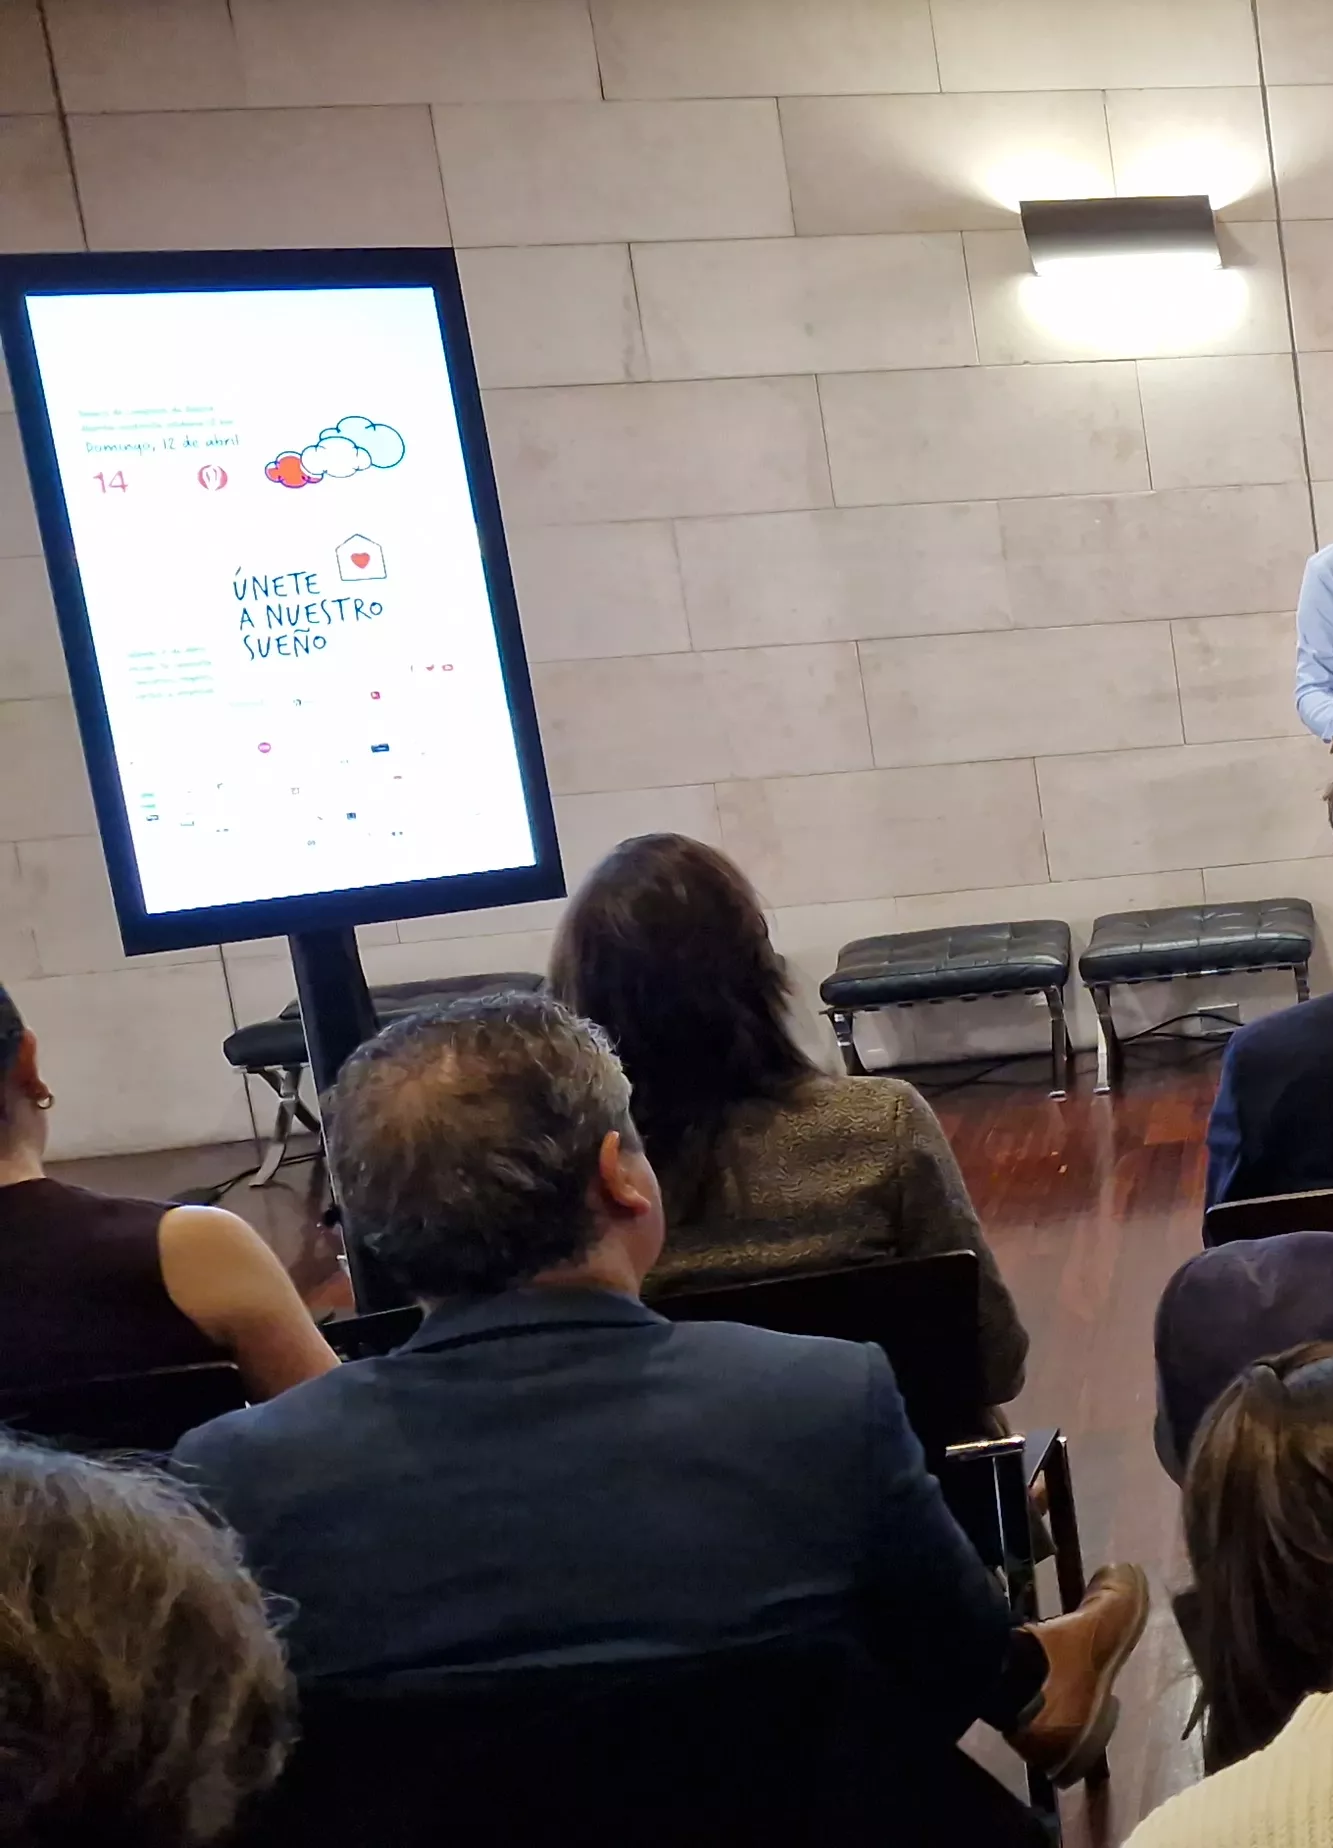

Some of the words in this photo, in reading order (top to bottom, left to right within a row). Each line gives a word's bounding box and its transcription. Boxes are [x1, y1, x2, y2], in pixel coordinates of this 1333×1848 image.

[85, 441, 156, 456] Domingo,
[163, 437, 176, 450] 12
[182, 434, 198, 448] de
[205, 434, 240, 447] abril
[93, 470, 128, 493] 14
[233, 566, 320, 601] ÚNETE
[240, 607, 255, 631] A
[266, 597, 383, 629] NUESTRO
[243, 627, 327, 661] SUEÑO
